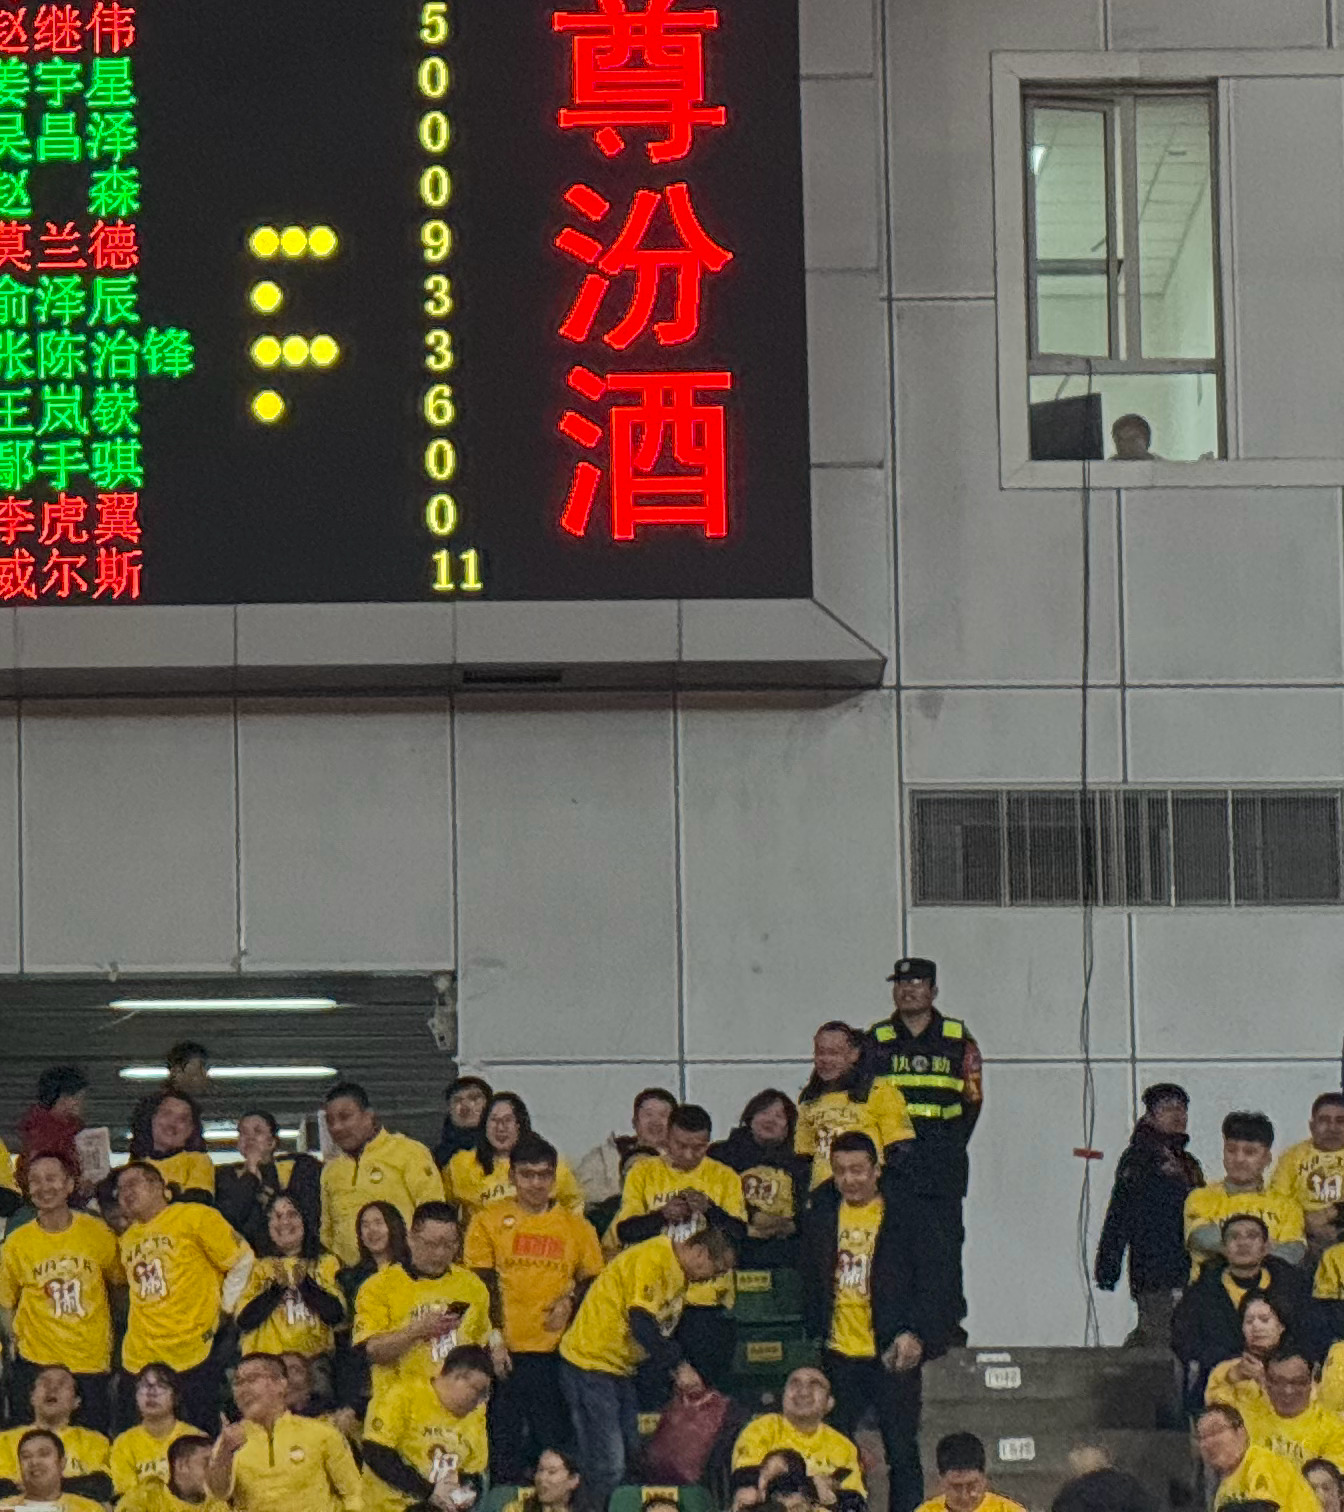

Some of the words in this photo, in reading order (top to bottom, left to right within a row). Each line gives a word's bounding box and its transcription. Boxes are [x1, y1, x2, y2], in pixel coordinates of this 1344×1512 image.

[420, 2, 448, 44] 5
[418, 57, 448, 98] 0
[419, 111, 449, 152] 0
[420, 166, 450, 206] 0
[421, 220, 451, 262] 9
[424, 275, 452, 317] 3
[425, 329, 453, 371] 3
[424, 384, 454, 426] 6
[425, 439, 455, 480] 0
[426, 494, 456, 535] 0
[432, 549, 481, 591] 11
